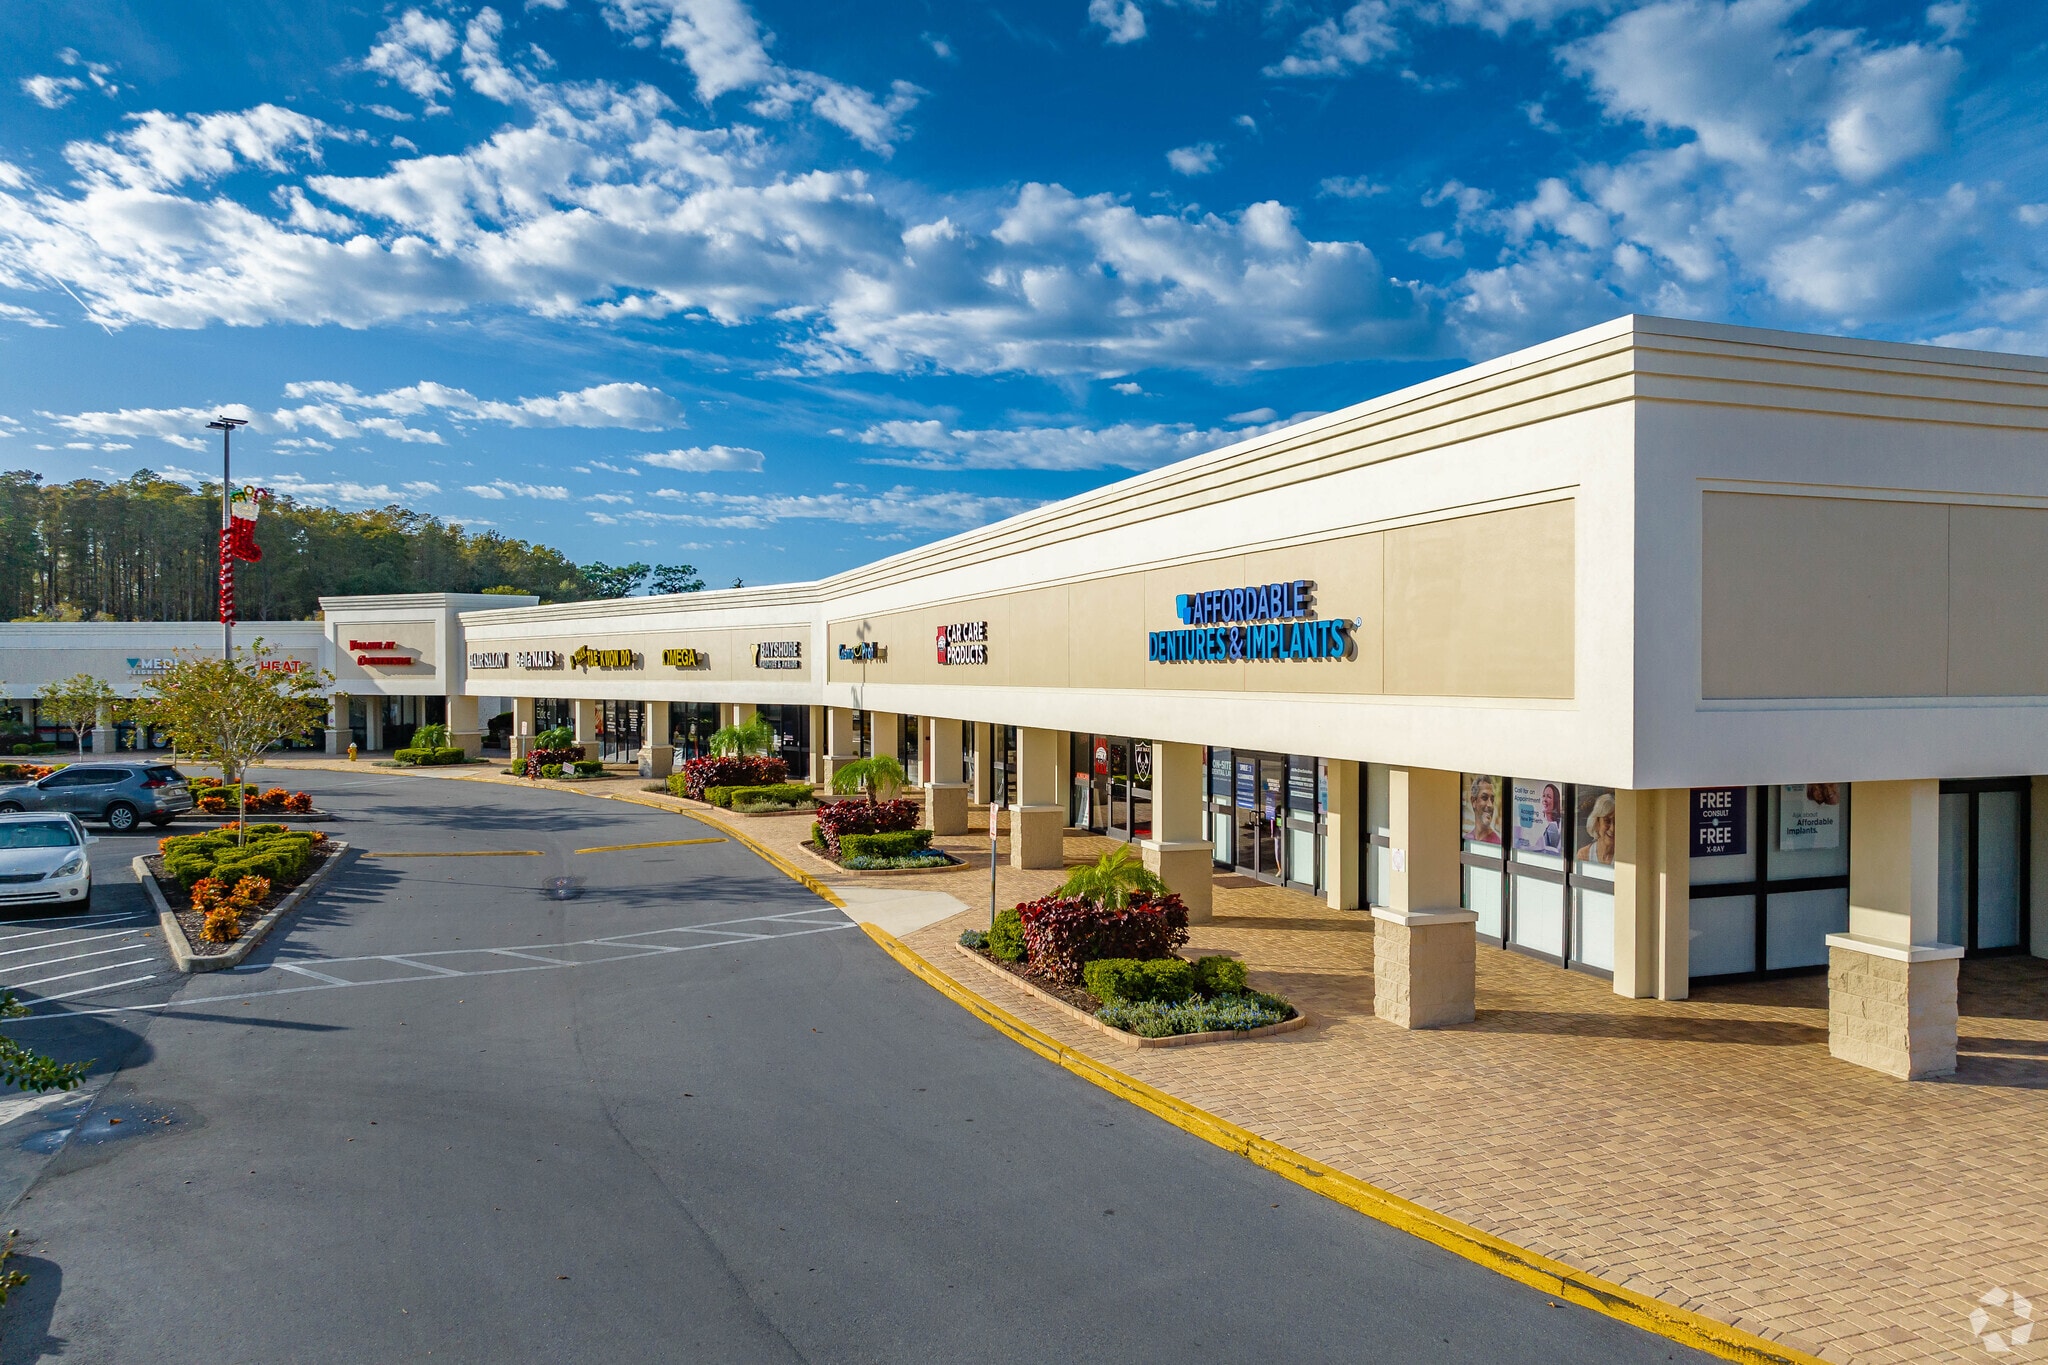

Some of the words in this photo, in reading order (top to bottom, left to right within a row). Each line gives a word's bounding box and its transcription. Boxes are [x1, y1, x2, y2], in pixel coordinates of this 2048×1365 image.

[1193, 580, 1306, 624] AFFORDABLE
[947, 624, 962, 642] CAR
[963, 621, 984, 641] CARE
[1149, 627, 1227, 661] DENTURES
[1228, 626, 1245, 660] &
[1246, 618, 1345, 659] IMPLANTS
[760, 641, 799, 658] BAYSHORE
[947, 645, 984, 664] PRODUCTS
[261, 660, 301, 673] HEAT
[484, 652, 507, 668] SALON
[515, 651, 532, 668] Bella
[532, 650, 555, 668] NAILS
[1700, 792, 1732, 809] FREE
[1702, 810, 1729, 818] CONSULT
[1796, 818, 1834, 827] Affordable
[1700, 827, 1732, 845] FREE
[1706, 845, 1726, 853] X-RAY
